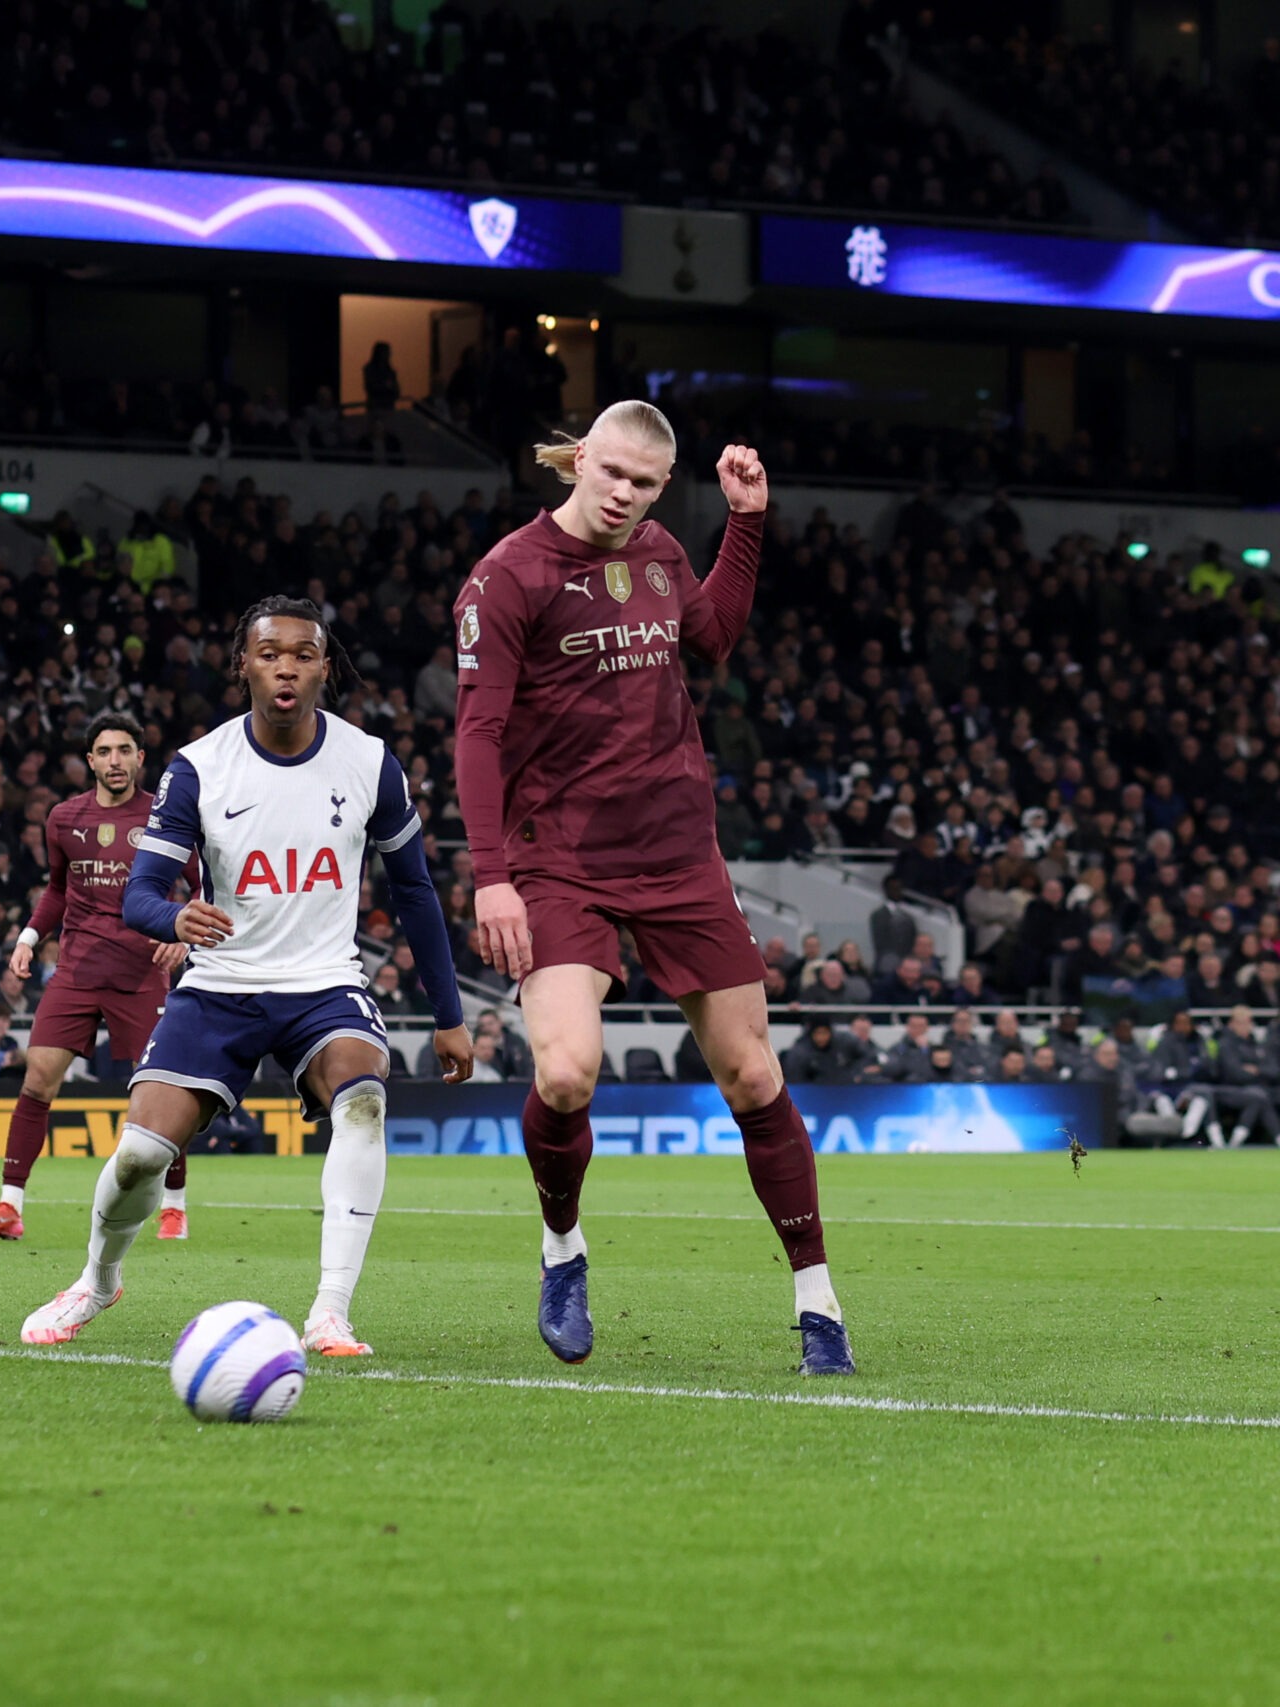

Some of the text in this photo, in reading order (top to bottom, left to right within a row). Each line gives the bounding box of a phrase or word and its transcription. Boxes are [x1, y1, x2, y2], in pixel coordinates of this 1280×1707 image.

[559, 620, 679, 655] ETIHAD
[597, 650, 670, 673] AIRWAYS
[69, 860, 133, 875] ETIHA
[234, 846, 343, 895] AIA
[780, 1212, 814, 1226] CITY
